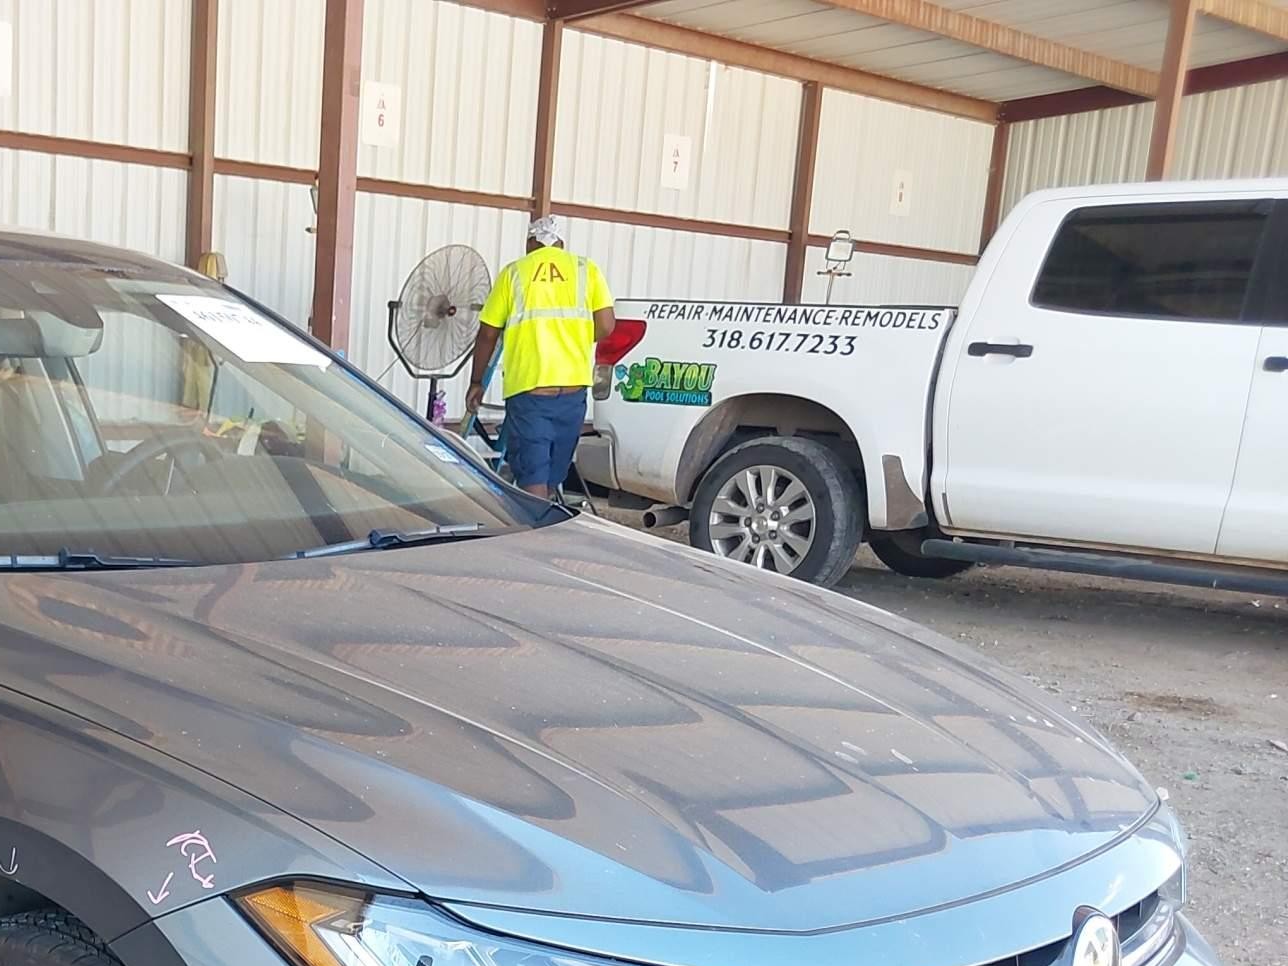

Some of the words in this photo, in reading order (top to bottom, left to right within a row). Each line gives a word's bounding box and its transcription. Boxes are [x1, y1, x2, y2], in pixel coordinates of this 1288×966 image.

[377, 113, 385, 128] 6
[673, 160, 679, 173] 7
[702, 328, 858, 356] 318.617.7233
[644, 357, 717, 392] BAYOU
[645, 390, 665, 401] POOL
[666, 391, 709, 404] SOLUTIONS
